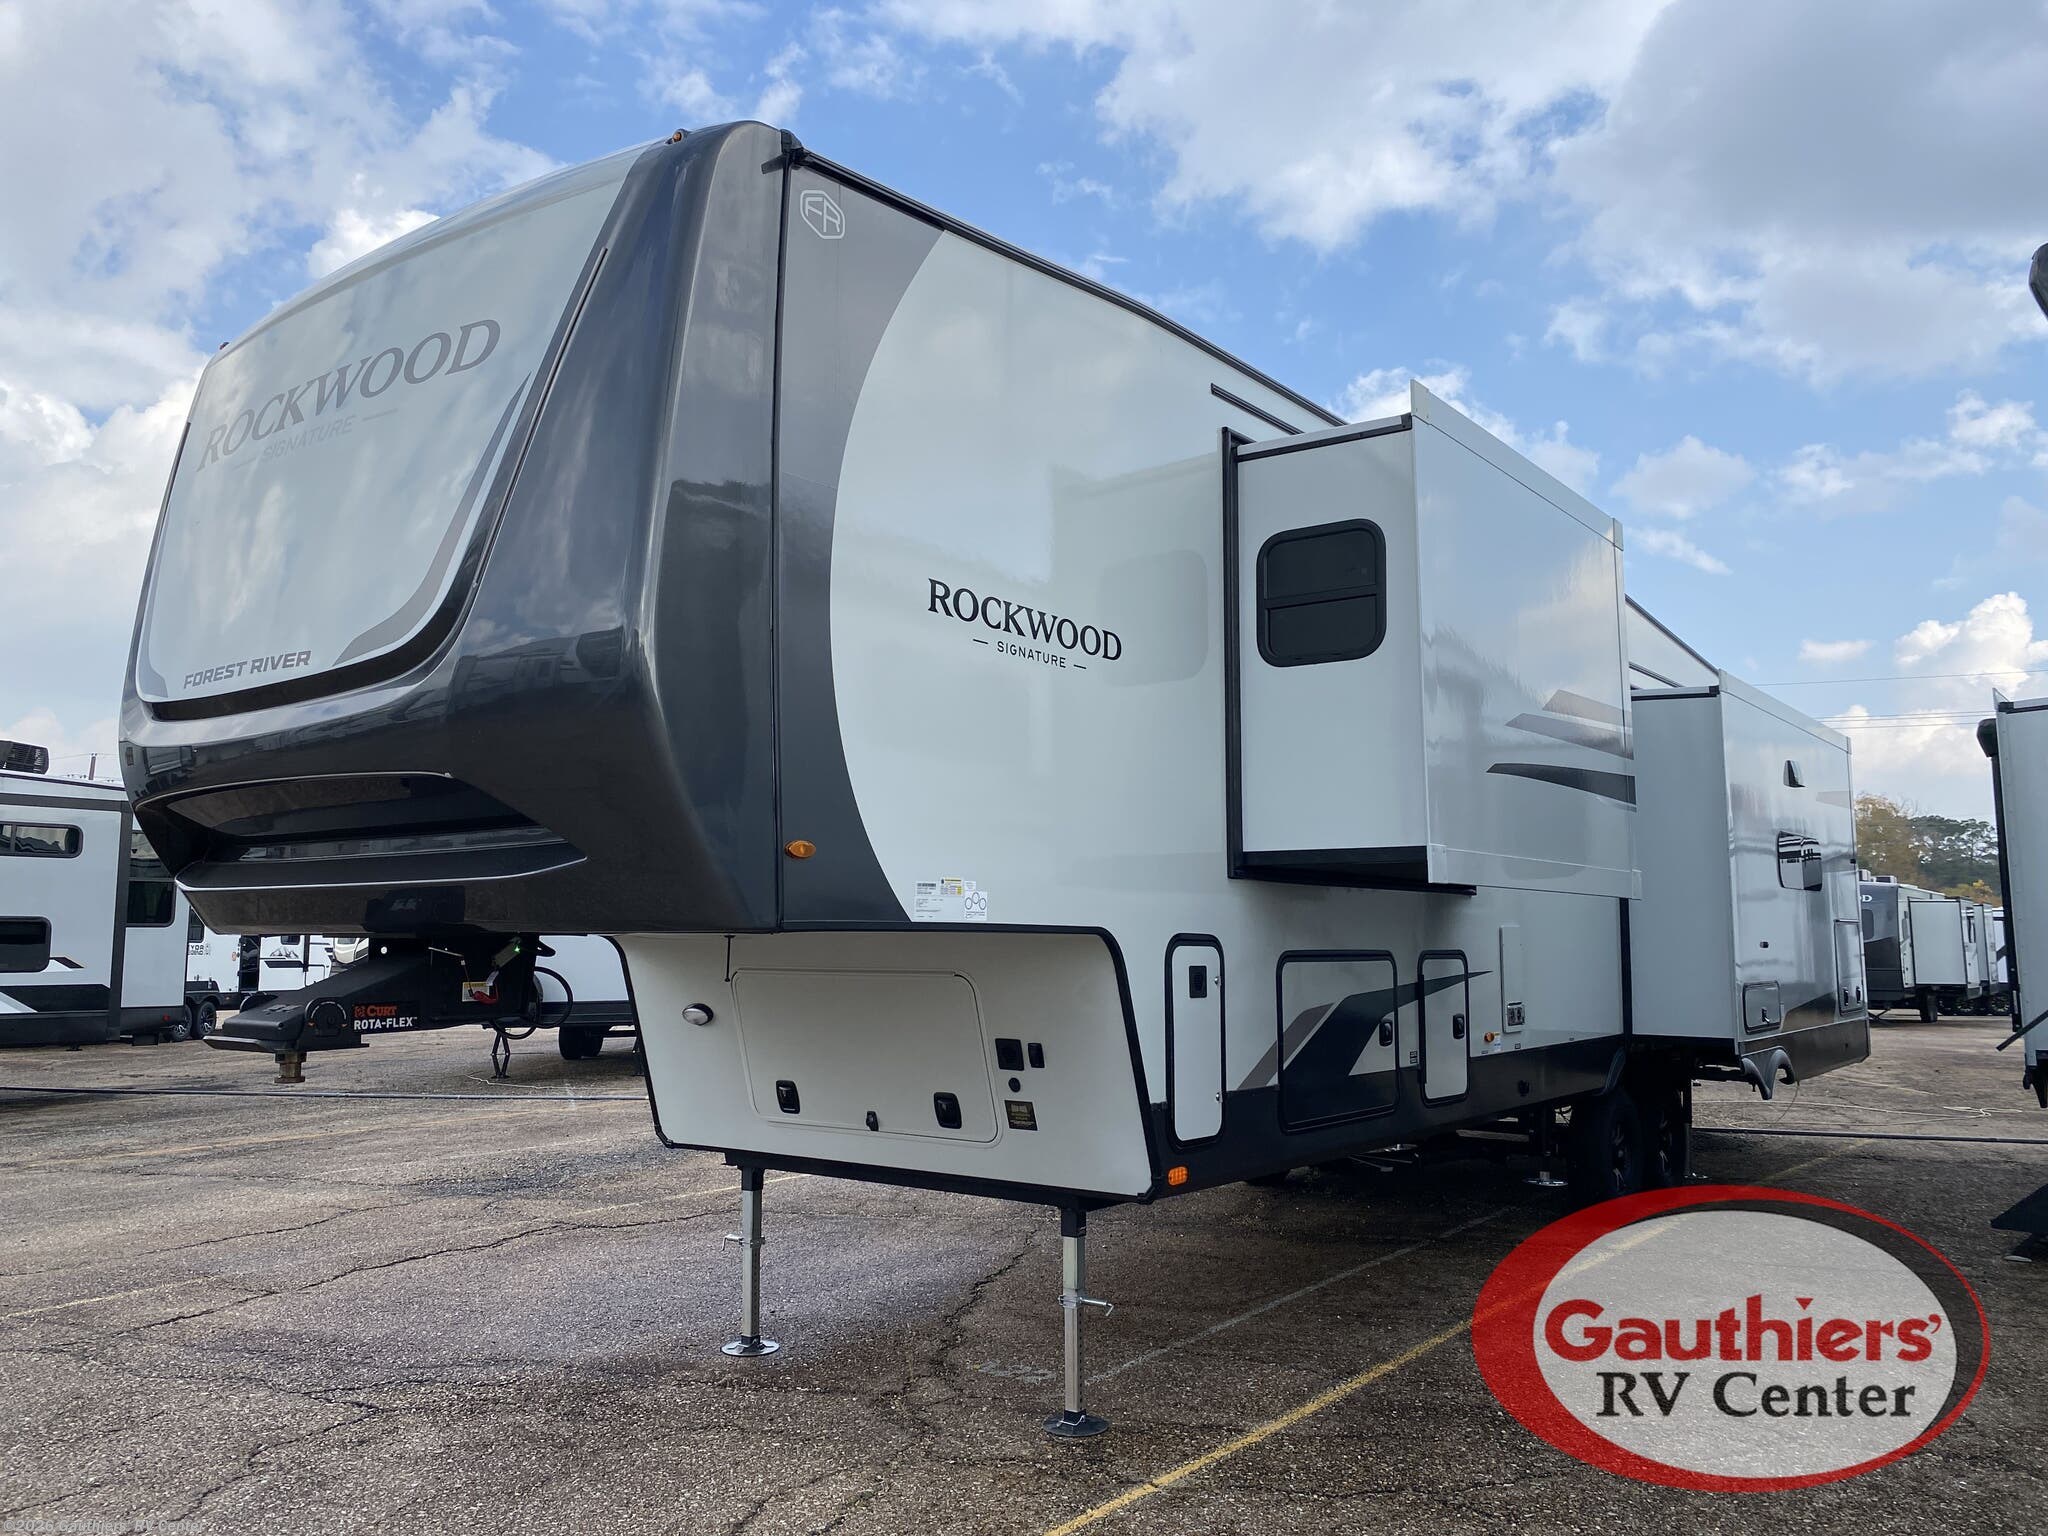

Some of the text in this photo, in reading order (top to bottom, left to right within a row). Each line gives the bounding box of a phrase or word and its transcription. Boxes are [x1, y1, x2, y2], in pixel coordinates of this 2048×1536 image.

[196, 319, 501, 473] ROCKWOOD
[262, 414, 356, 463] SIGNATURE
[927, 577, 1122, 661] ROCKWOOD
[183, 650, 312, 689] FOREST RIVER
[996, 640, 1066, 669] SIGNATURE
[353, 1016, 413, 1030] ROTA-FLEX
[366, 1004, 398, 1017] CURT
